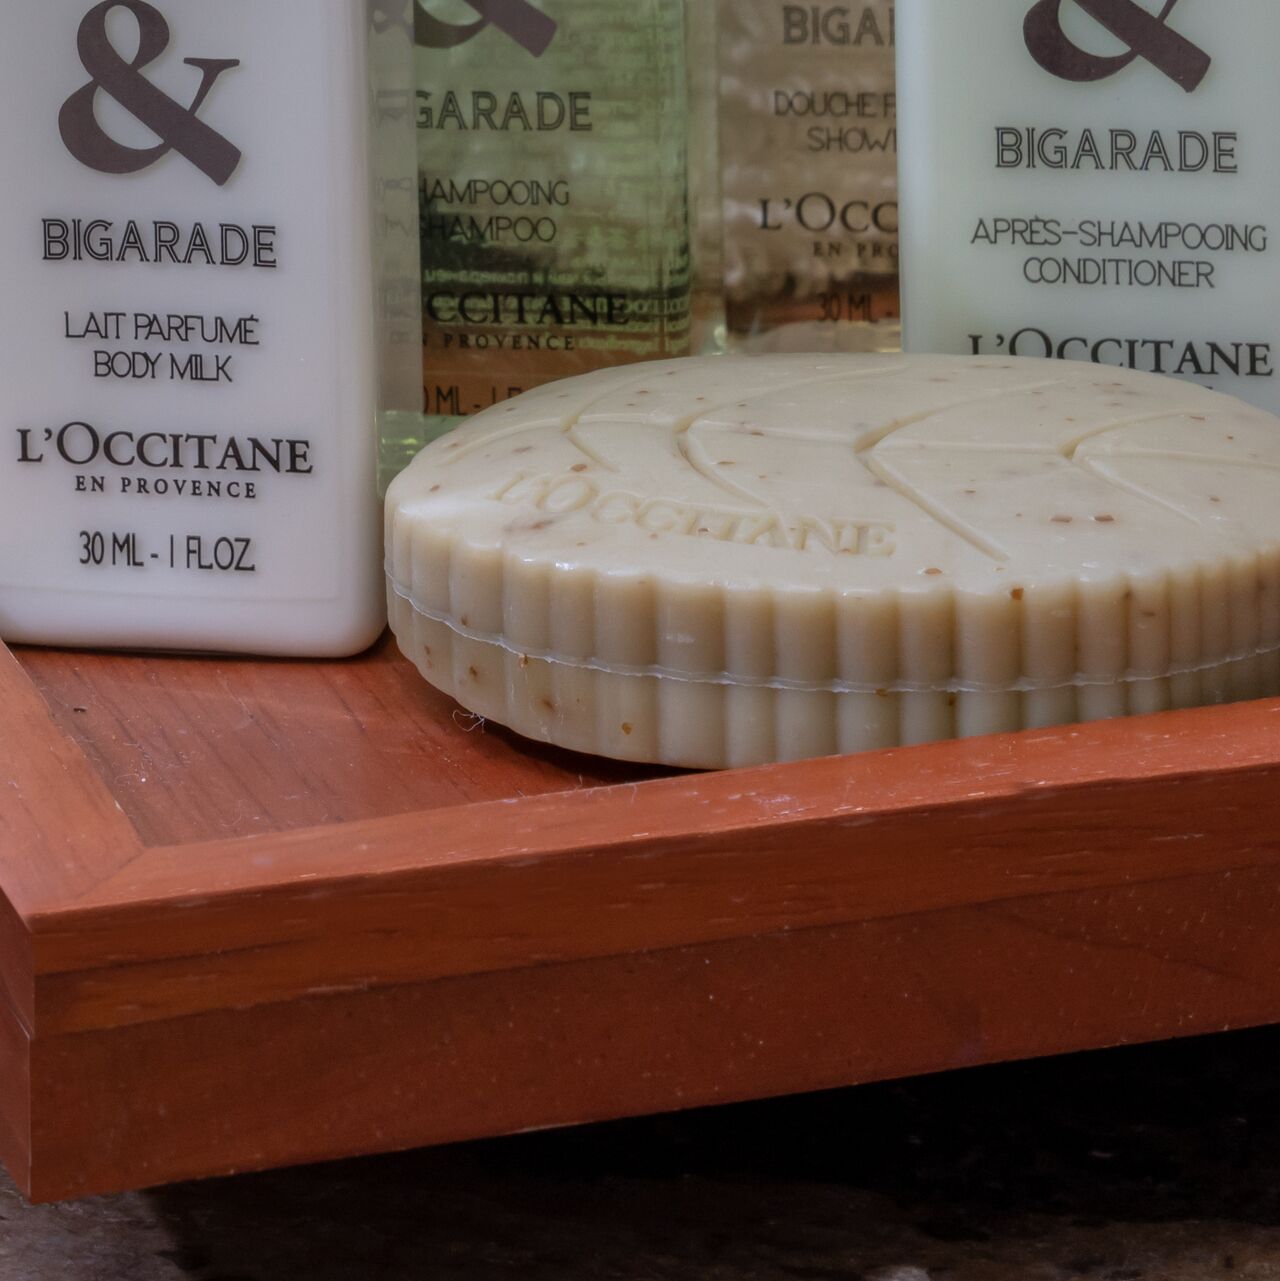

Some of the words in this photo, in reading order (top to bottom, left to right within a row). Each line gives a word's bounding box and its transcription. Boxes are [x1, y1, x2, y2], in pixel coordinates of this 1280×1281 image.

[782, 5, 895, 46] BIGA
[416, 90, 593, 132] GARADE
[807, 125, 897, 153] SHOW
[994, 126, 1238, 174] BIGARADE
[758, 192, 899, 234] L'OCC
[41, 218, 278, 269] BIGARADE
[970, 216, 1268, 252] APRÈS-SHAMPOOING
[1023, 257, 1216, 288] CONDITIONER
[425, 291, 629, 326] CCITANE
[64, 311, 126, 340] LAIT
[133, 313, 260, 346] PARFUMÉ
[443, 332, 577, 352] PROVENCE
[93, 350, 163, 379] BODY
[169, 352, 233, 382] MILK
[16, 421, 313, 474] L'OCCITANE
[74, 475, 105, 492] EN
[120, 476, 257, 499] PROVENCE
[79, 530, 105, 565] 30
[112, 532, 145, 567] ML
